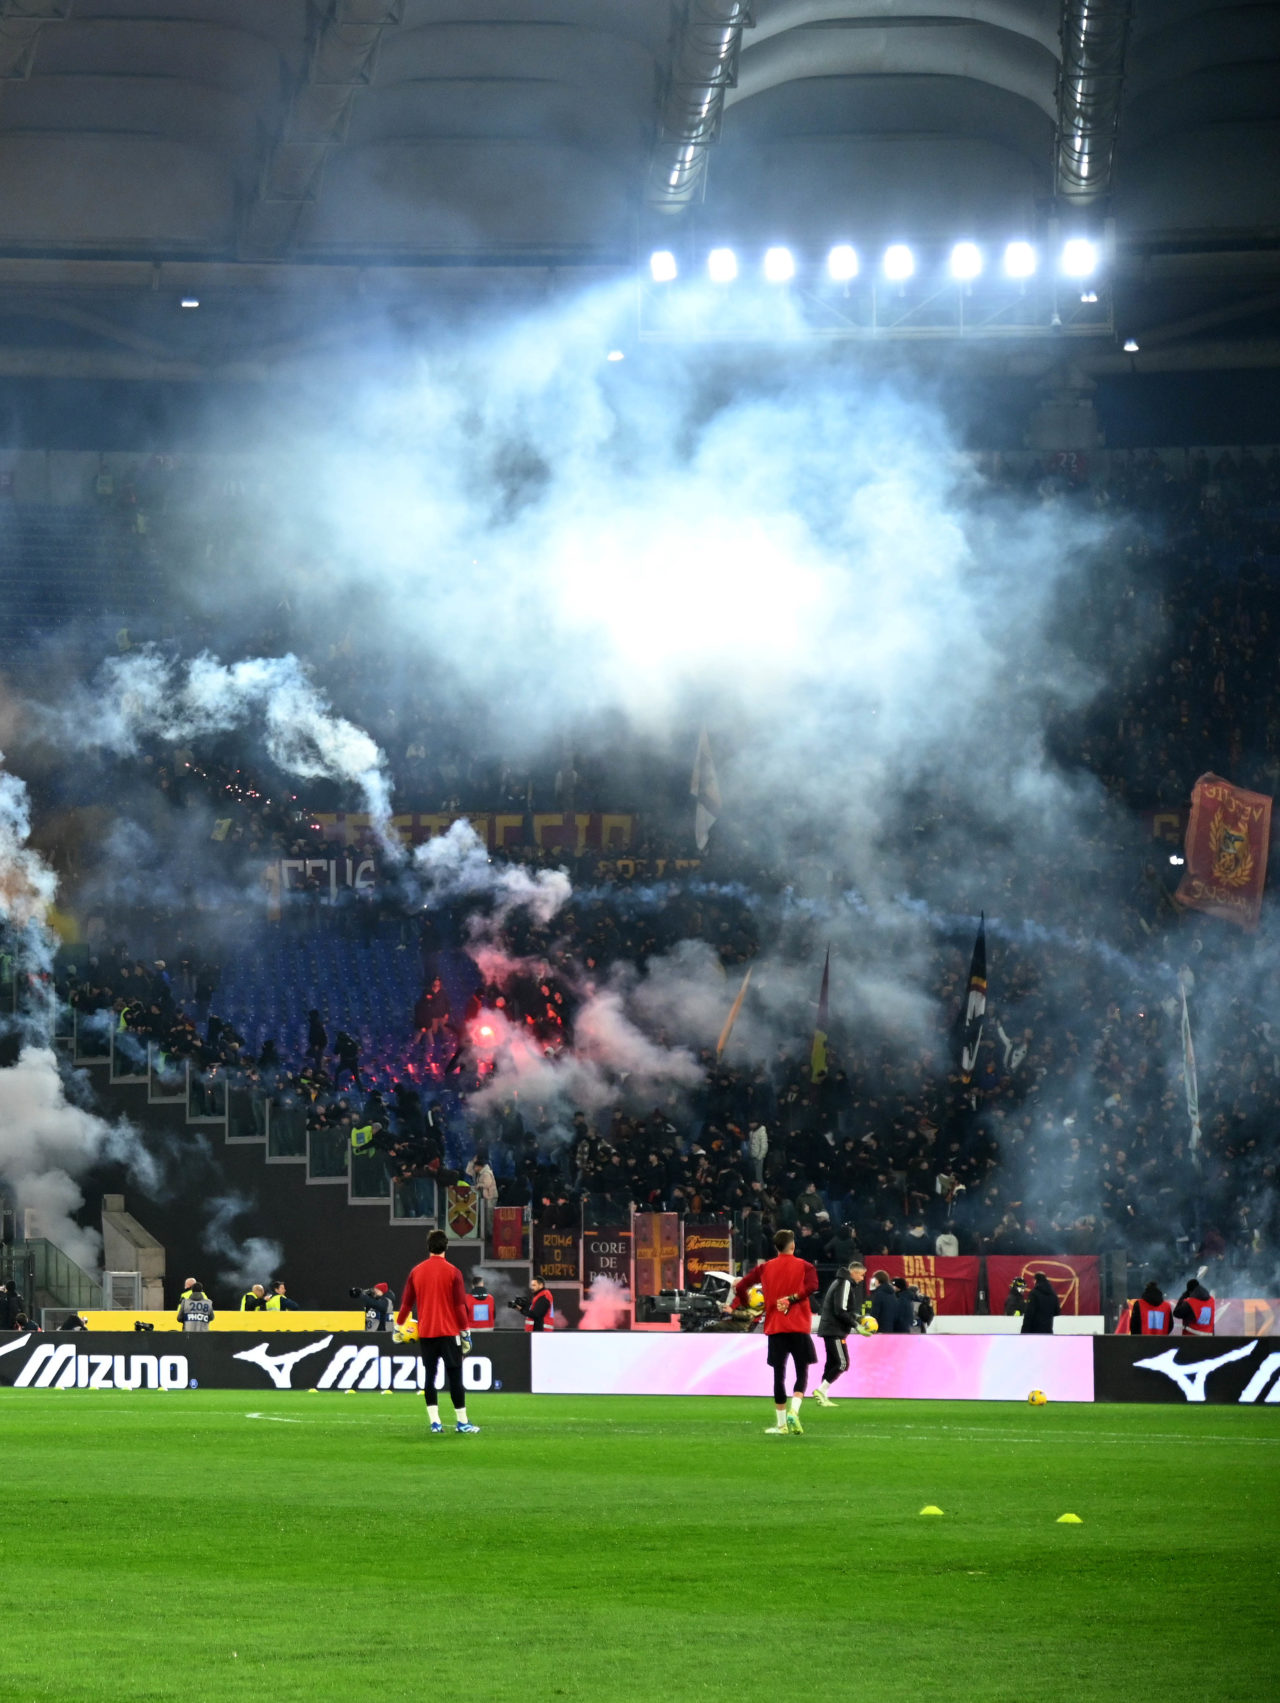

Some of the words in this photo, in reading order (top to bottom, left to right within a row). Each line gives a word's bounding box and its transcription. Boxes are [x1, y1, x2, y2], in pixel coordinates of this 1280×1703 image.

[544, 1234, 573, 1247] ROMA
[590, 1241, 626, 1254] CORE
[600, 1256, 617, 1269] DE
[540, 1263, 576, 1277] MORTE
[589, 1270, 628, 1284] ROMA
[189, 1302, 209, 1313] 208
[13, 1343, 189, 1389] MIZUNO
